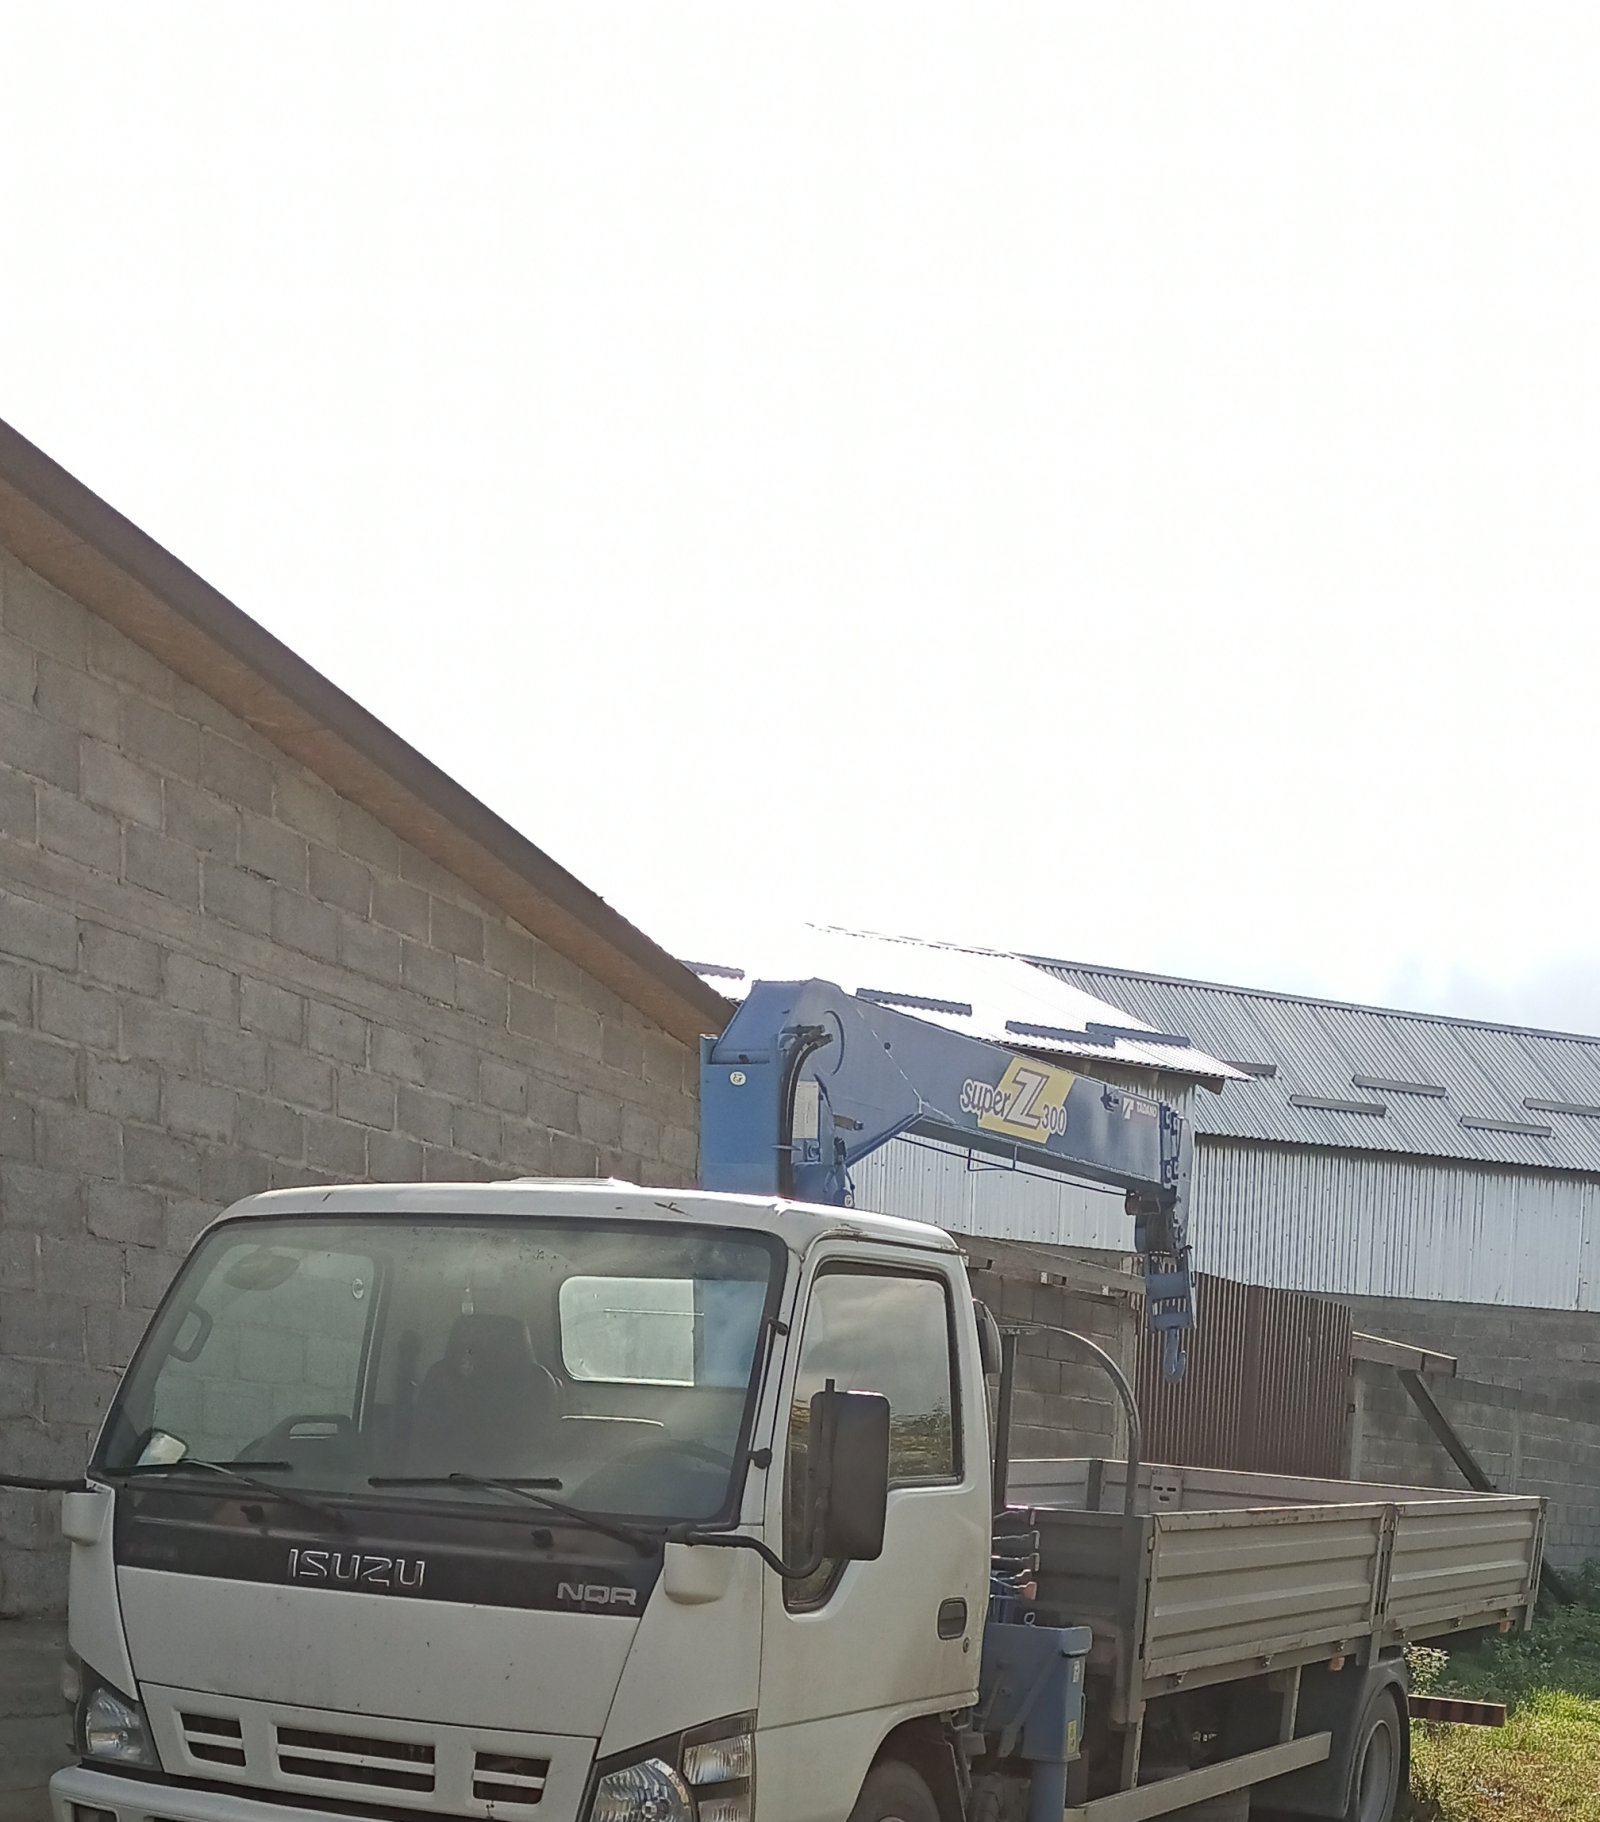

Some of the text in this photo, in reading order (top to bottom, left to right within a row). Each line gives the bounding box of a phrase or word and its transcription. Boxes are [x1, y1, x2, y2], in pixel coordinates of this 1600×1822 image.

[1043, 1104, 1066, 1134] 300
[287, 1548, 426, 1587] ISUZU
[557, 1581, 637, 1606] NQR
